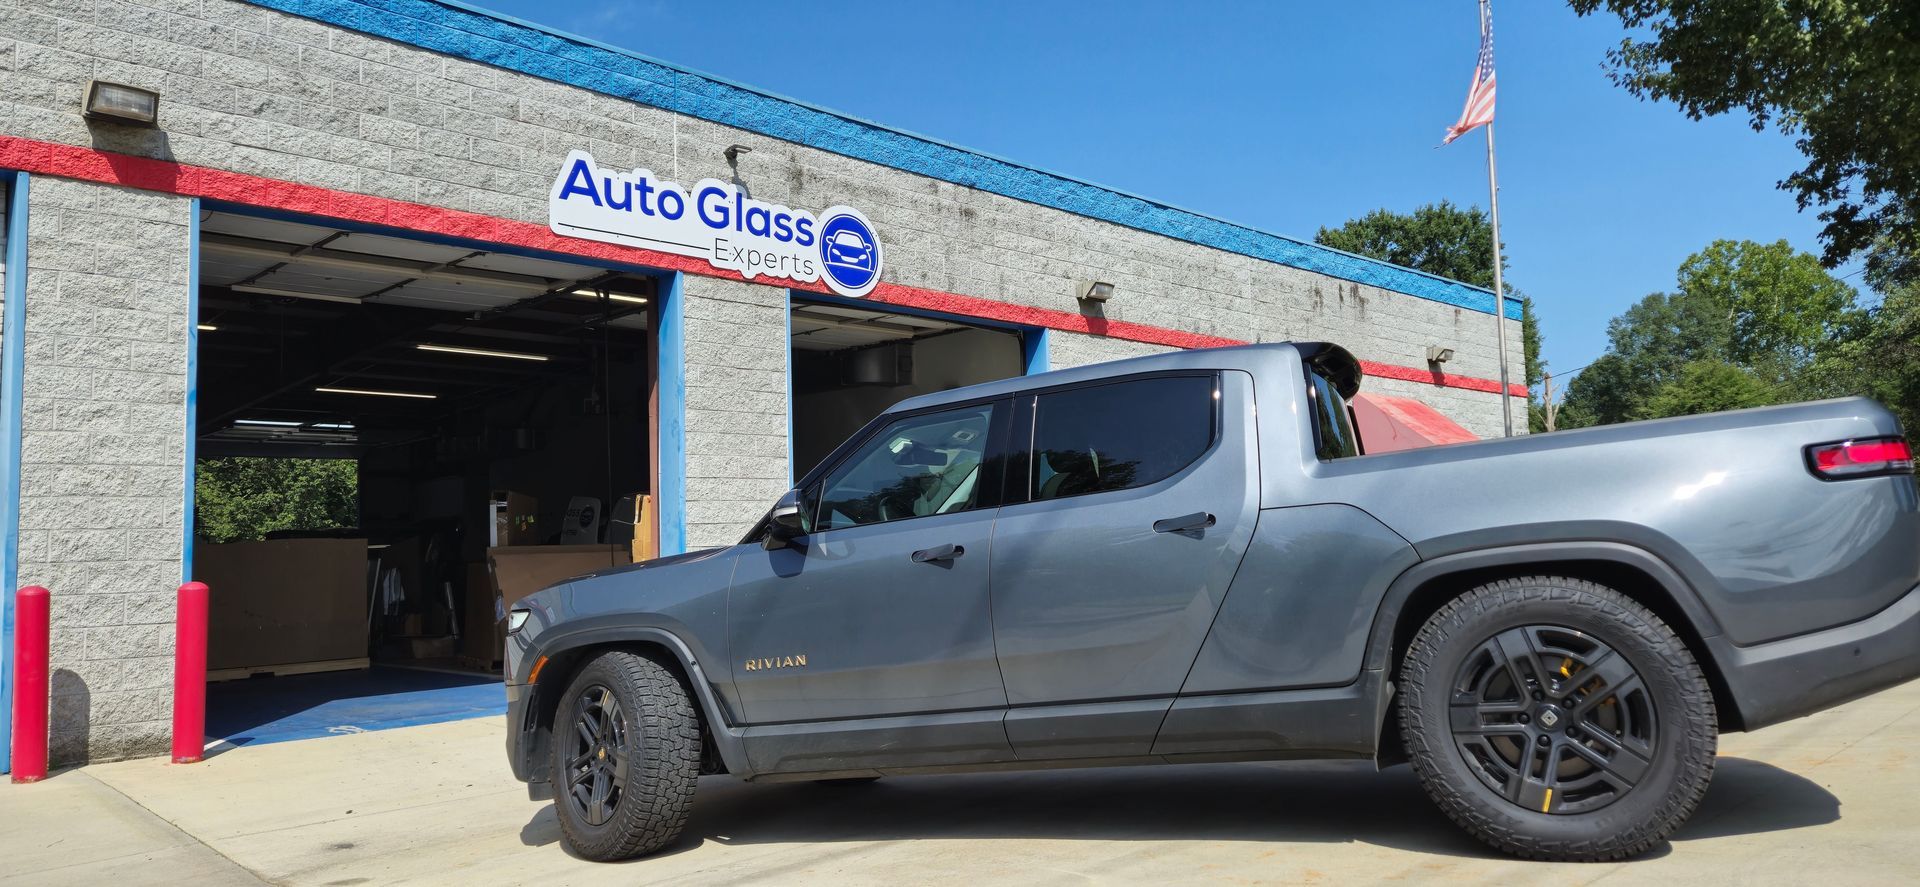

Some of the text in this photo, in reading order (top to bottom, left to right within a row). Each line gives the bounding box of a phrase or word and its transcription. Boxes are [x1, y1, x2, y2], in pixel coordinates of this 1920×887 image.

[559, 159, 815, 247] Auto Glass
[714, 237, 814, 276] Experts
[745, 654, 807, 671] RIVIAN
